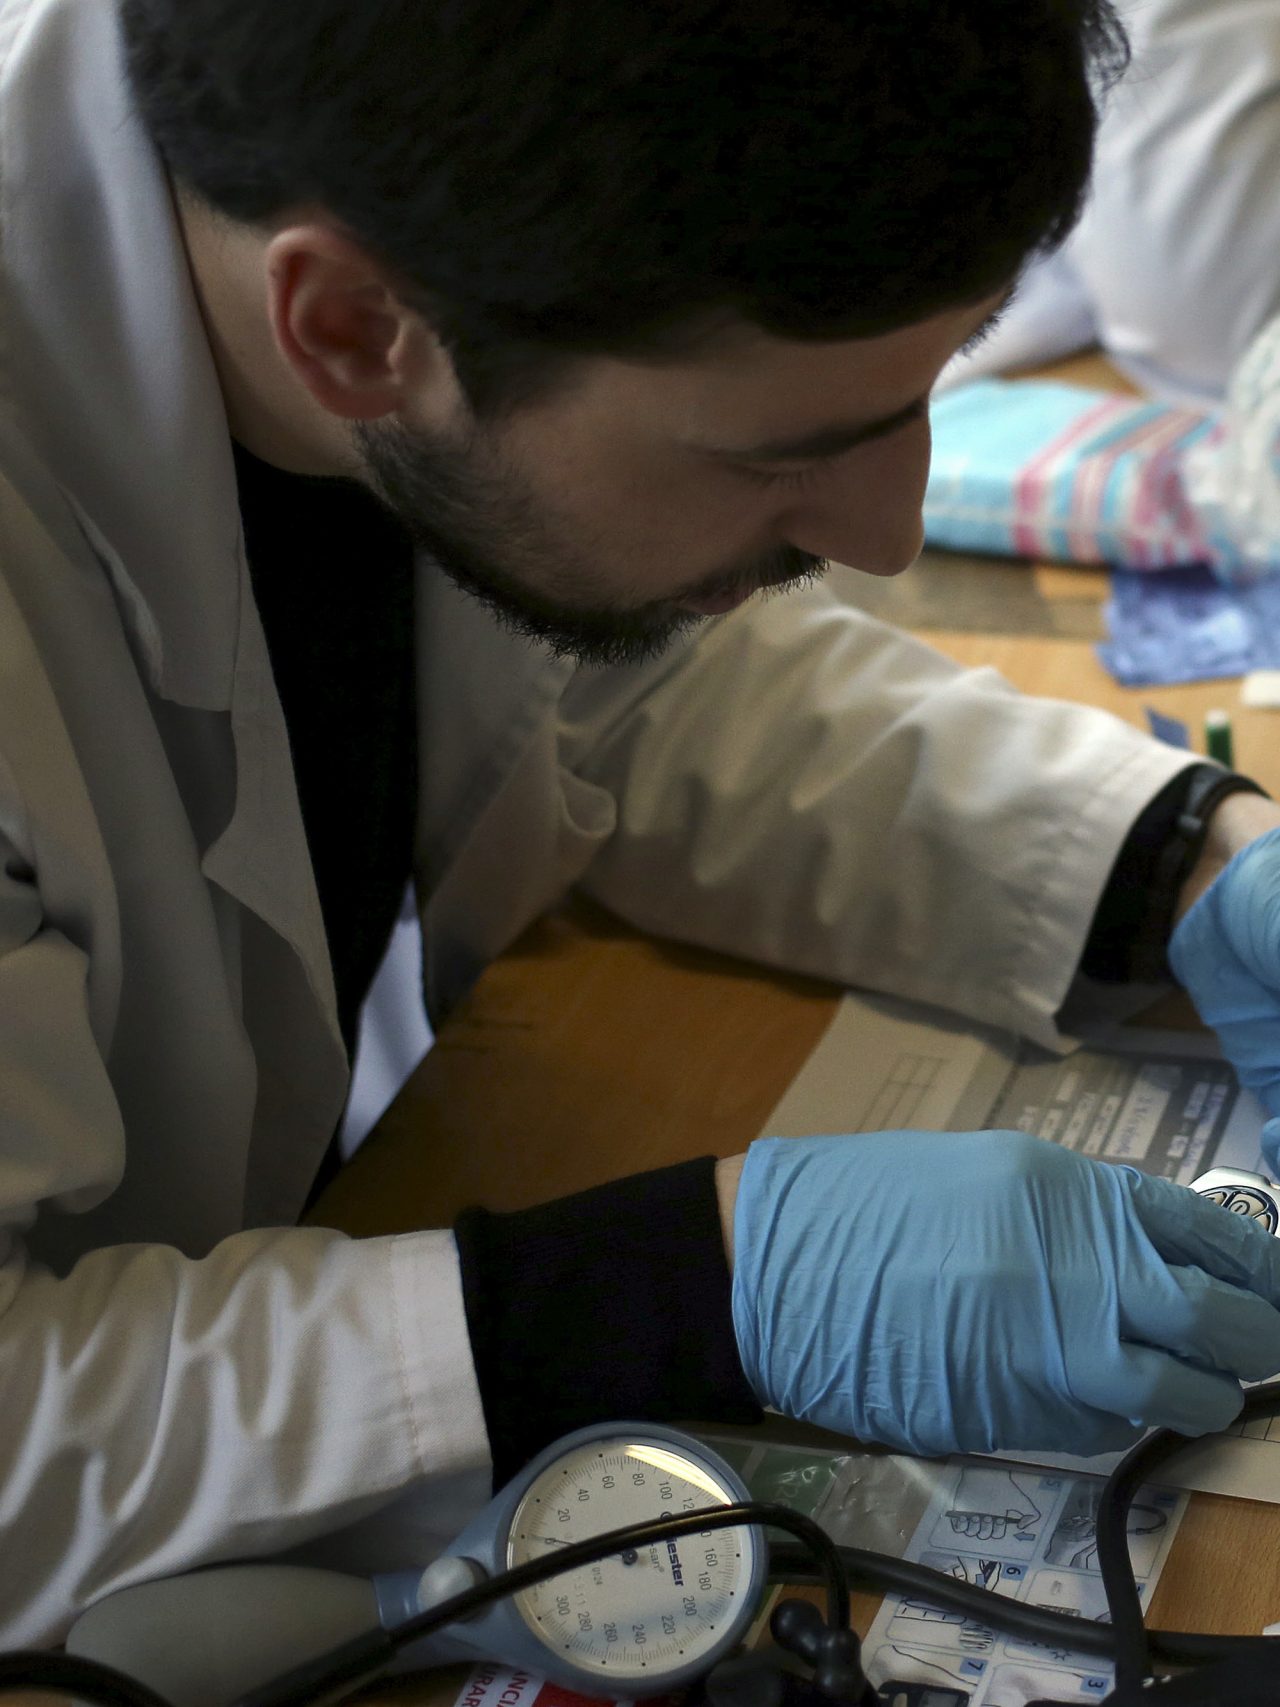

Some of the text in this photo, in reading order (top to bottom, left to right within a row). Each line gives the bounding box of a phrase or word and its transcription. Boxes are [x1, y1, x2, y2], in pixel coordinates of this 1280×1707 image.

[602, 1476, 615, 1489] 60
[632, 1473, 645, 1486] 80
[577, 1488, 590, 1502] 40
[659, 1481, 673, 1500] 100
[683, 1498, 695, 1511] 12
[558, 1508, 571, 1523] 20
[666, 1537, 684, 1587] iester
[704, 1547, 718, 1567] 160
[698, 1571, 711, 1591] 180
[1005, 1567, 1021, 1576] 6
[556, 1596, 571, 1616] 300
[683, 1595, 697, 1617] 200
[578, 1611, 593, 1632] 280
[661, 1615, 676, 1635] 220
[603, 1622, 618, 1643] 260
[632, 1624, 647, 1644] 240
[967, 1660, 983, 1670] 7
[1088, 1679, 1104, 1689] 3
